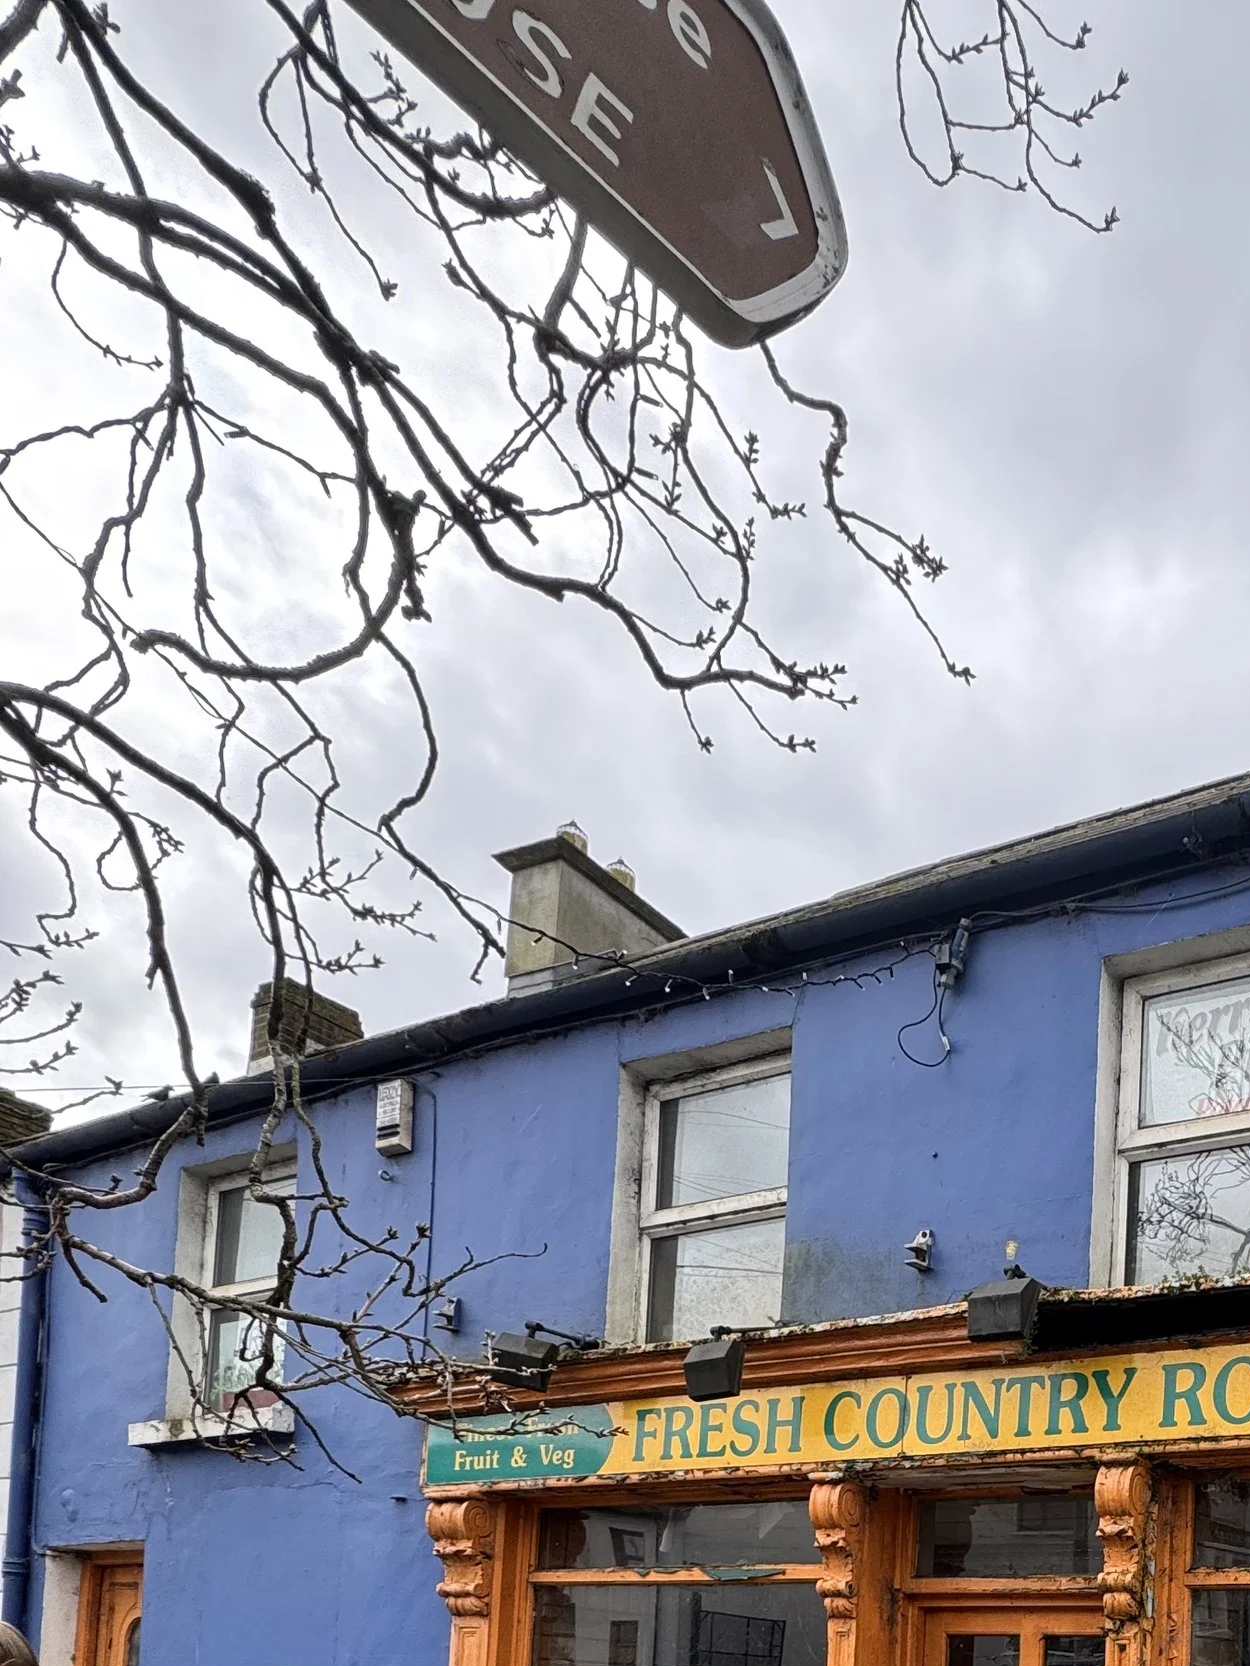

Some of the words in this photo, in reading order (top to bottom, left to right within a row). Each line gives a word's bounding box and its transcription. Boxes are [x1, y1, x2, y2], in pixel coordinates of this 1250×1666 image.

[638, 0, 712, 70] e
[632, 1395, 806, 1462] FRESH
[822, 1367, 1138, 1450] COUNTRY
[454, 1448, 500, 1471] Fruit
[510, 1446, 528, 1468] &
[539, 1444, 576, 1469] Veg
